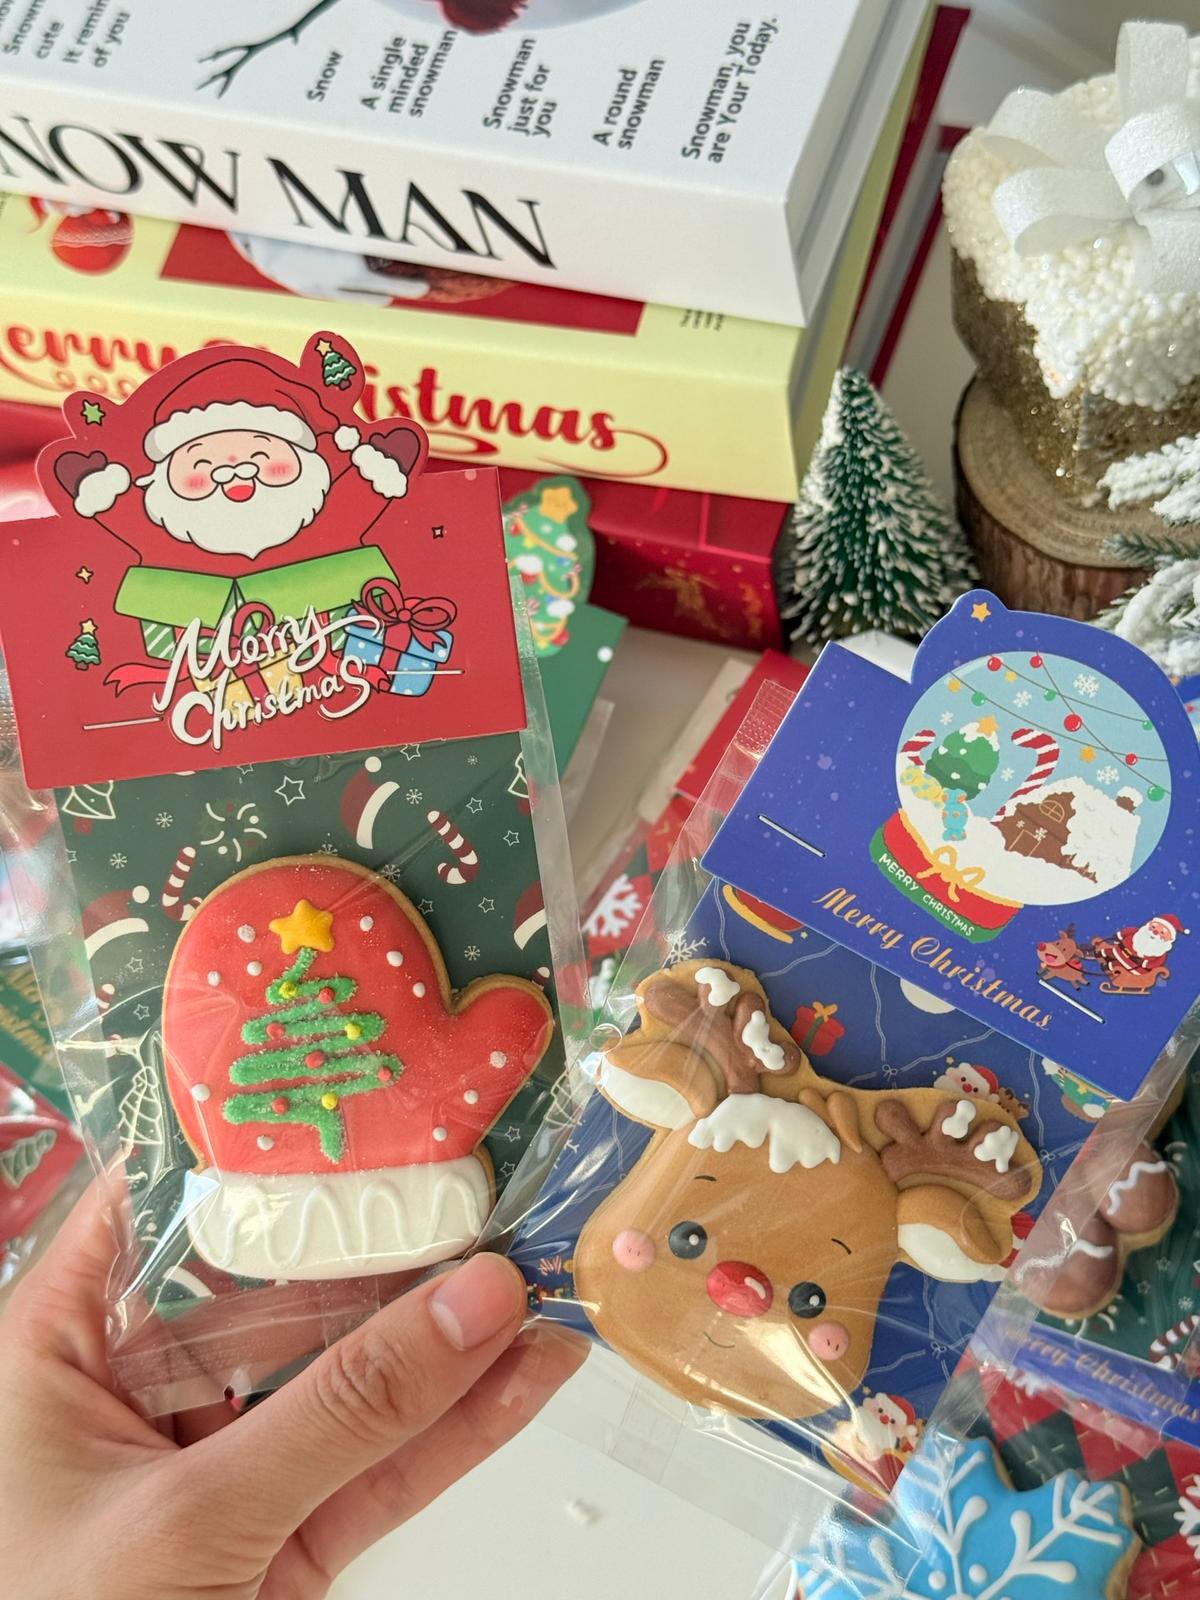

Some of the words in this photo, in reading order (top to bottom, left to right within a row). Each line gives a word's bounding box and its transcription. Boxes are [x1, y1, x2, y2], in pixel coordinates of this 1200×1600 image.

[36, 21, 64, 59] cute
[61, 49, 83, 64] It
[93, 47, 112, 68] of
[104, 12, 131, 46] you
[306, 51, 343, 102] Snow
[360, 96, 380, 110] A
[371, 36, 406, 90] single
[410, 29, 458, 117] snowman
[735, 18, 779, 76] Today.
[388, 43, 429, 113] minded
[482, 37, 537, 129] Snowman
[507, 96, 539, 136] just
[524, 64, 550, 92] for
[592, 131, 614, 146] A
[603, 68, 638, 126] round
[617, 58, 666, 149] snowman
[681, 62, 738, 160] Snowman,
[725, 22, 750, 57] you
[716, 81, 750, 126] Your
[531, 100, 558, 138] you
[708, 132, 731, 163] are
[267, 157, 557, 269] MAN
[152, 605, 386, 713] Merry
[169, 655, 373, 750] Christmas
[878, 852, 920, 892] MERRY
[922, 893, 976, 938] CHRISTMAS
[812, 886, 904, 950] Merry
[909, 936, 1054, 1031] Christmas
